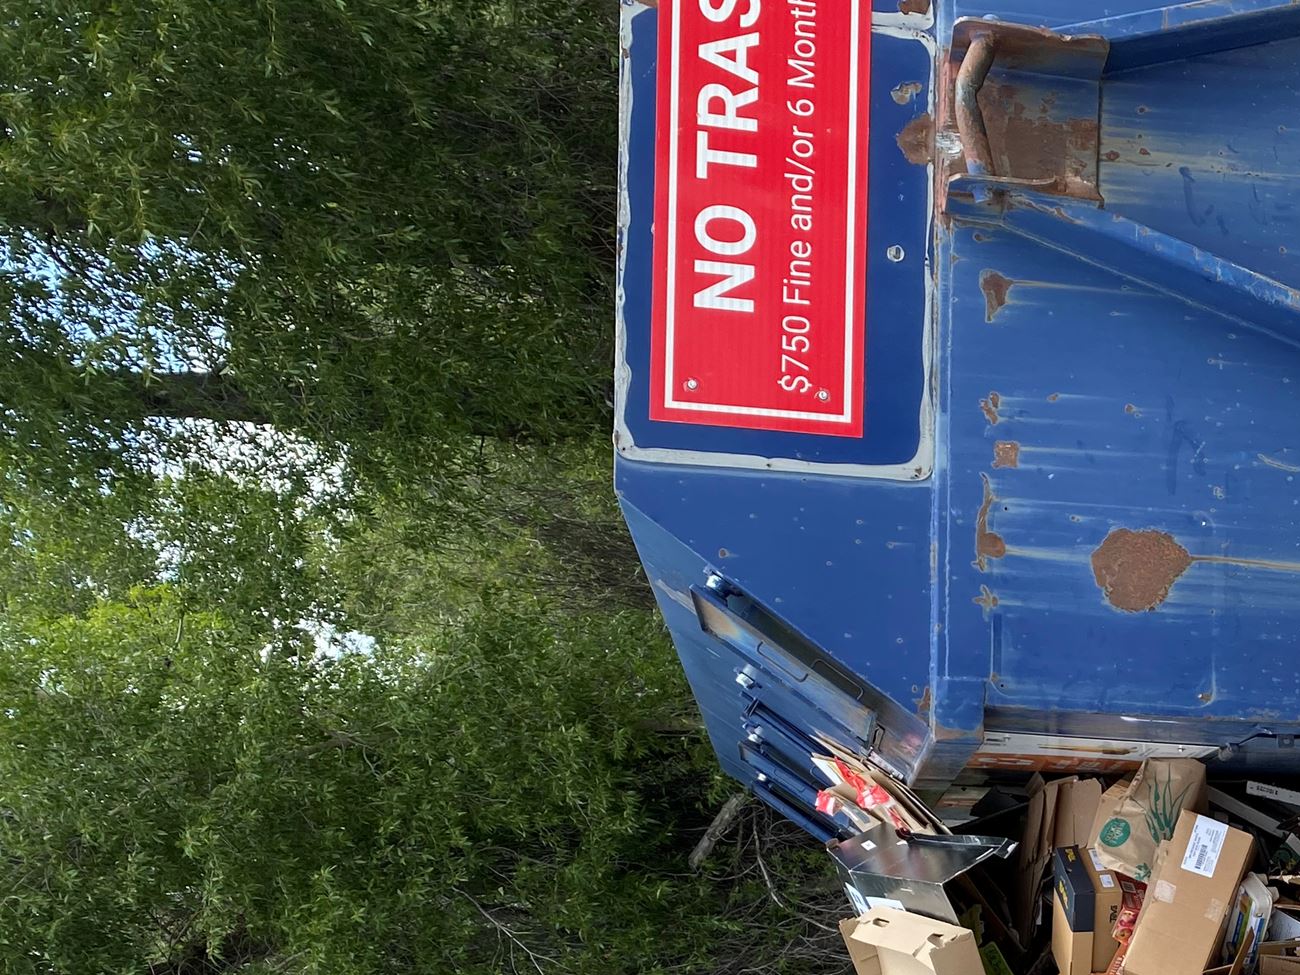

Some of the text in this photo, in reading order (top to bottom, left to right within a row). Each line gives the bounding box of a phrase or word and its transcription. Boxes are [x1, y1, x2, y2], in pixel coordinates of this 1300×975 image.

[786, 98, 815, 117] 6
[785, 125, 815, 231] and/or
[693, 204, 757, 313] NO
[783, 240, 812, 305] Fine
[777, 315, 813, 394] $750
